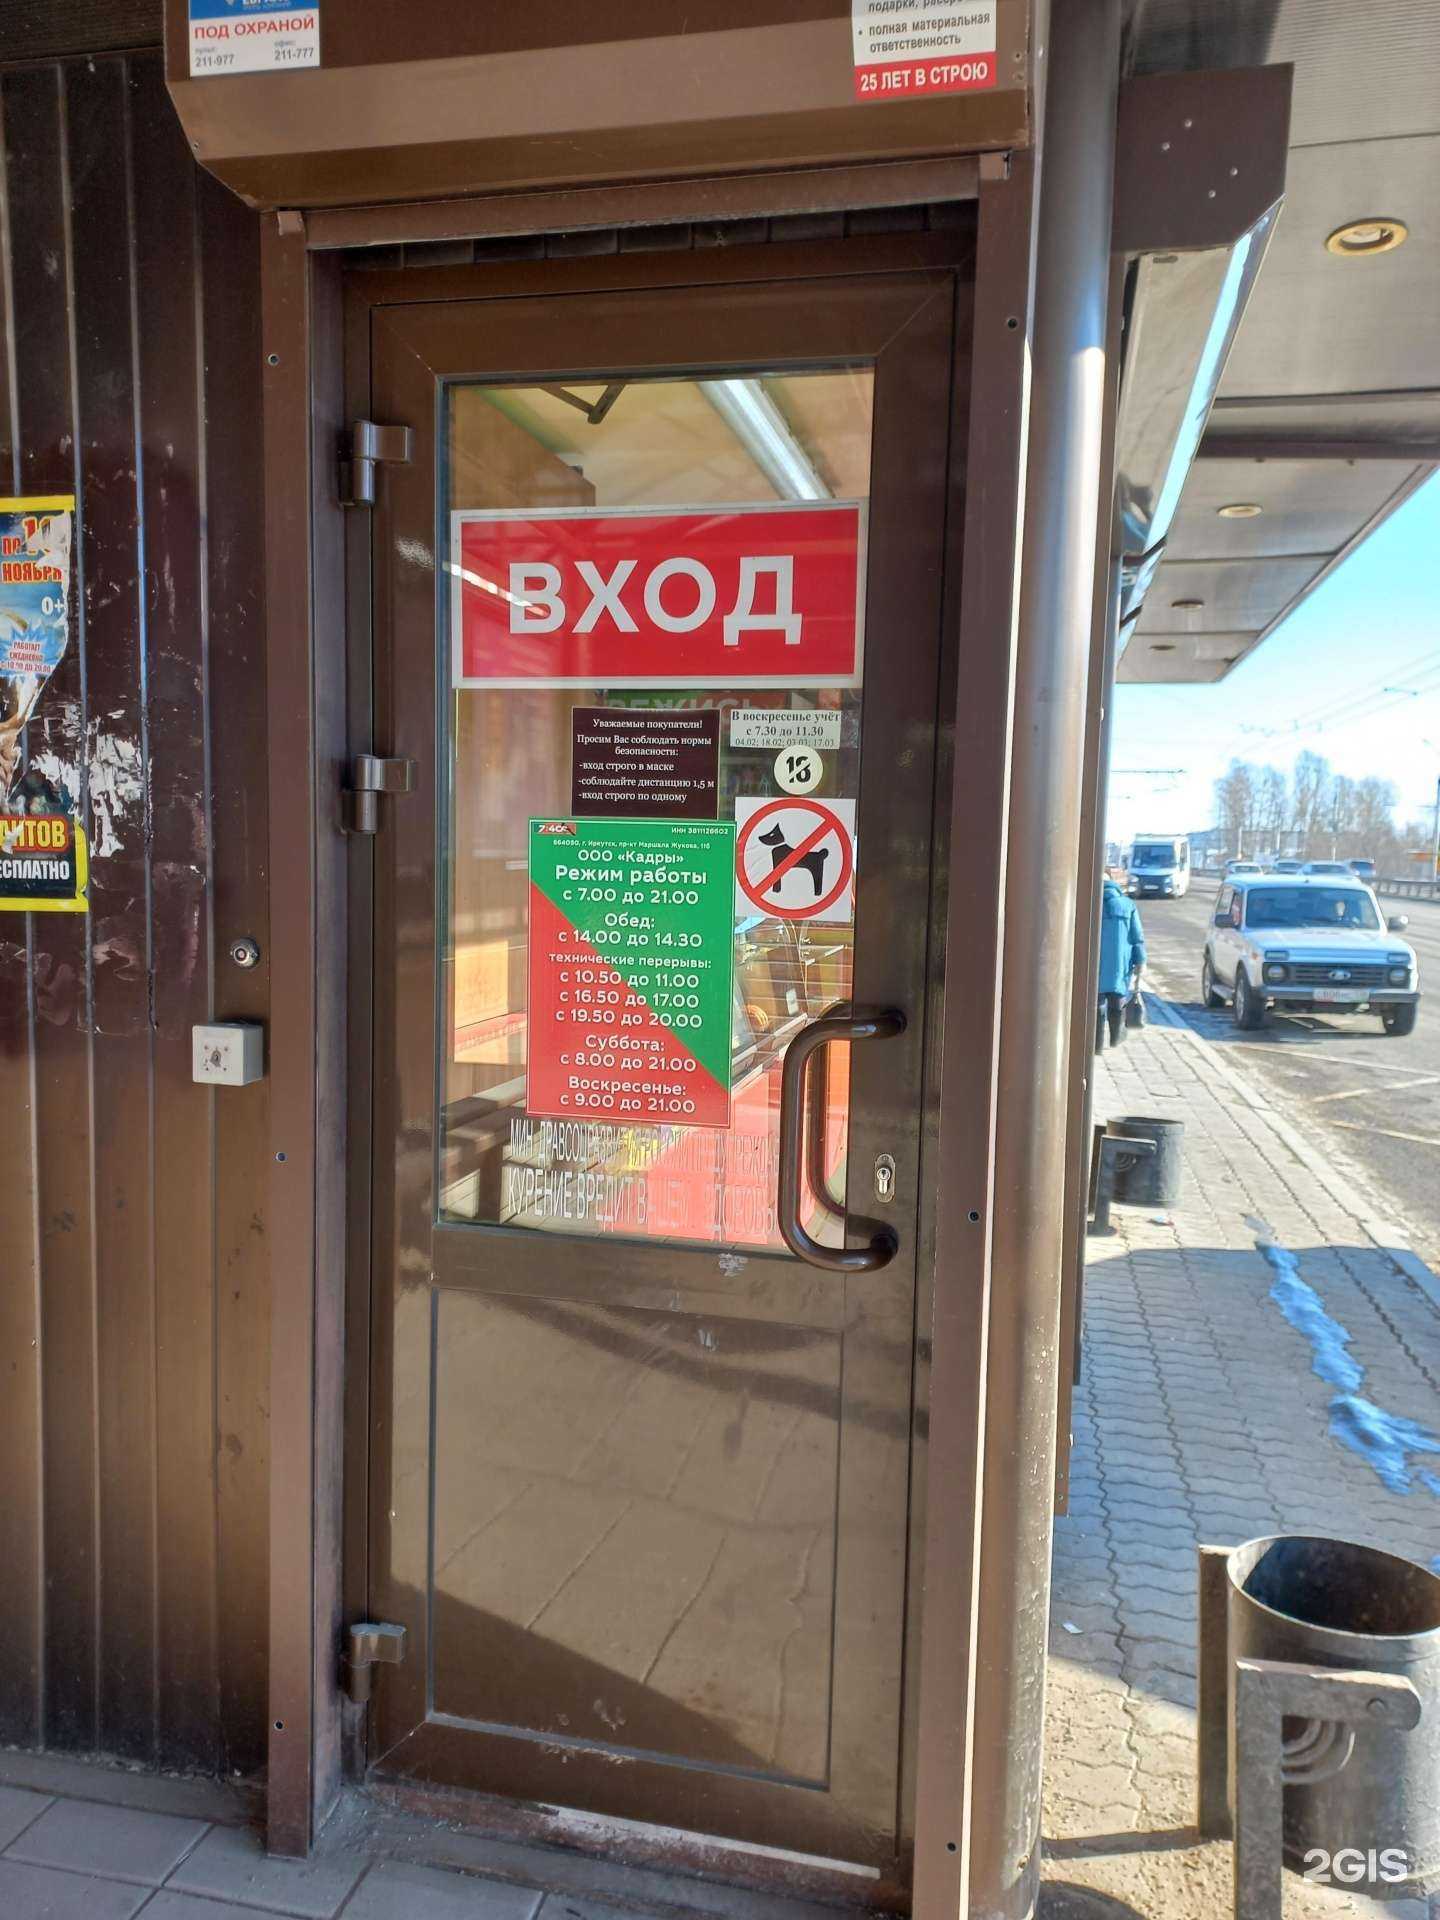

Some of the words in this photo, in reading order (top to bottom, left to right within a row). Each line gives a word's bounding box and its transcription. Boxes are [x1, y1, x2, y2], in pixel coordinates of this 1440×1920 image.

[194, 25, 230, 39] ПОД
[234, 14, 314, 36] ОХРАНОЙ
[869, 22, 907, 36] полная
[912, 13, 990, 32] материальная
[870, 34, 961, 53] ответственность
[196, 54, 235, 68] 211-977
[275, 47, 314, 61] 211-777
[860, 74, 878, 92] 25
[881, 70, 910, 90] ЛЕТ
[916, 68, 926, 86] В
[930, 62, 988, 85] СТРОЮ
[41, 596, 64, 614] 0+
[509, 555, 802, 646] ВХОД
[592, 718, 644, 728] Уважаемые
[647, 720, 703, 730] покупатели!
[732, 711, 740, 720] В
[743, 712, 811, 724] воскресенье
[814, 712, 840, 723] учёт
[577, 734, 611, 746] Просим
[614, 735, 629, 744] Вас
[630, 736, 679, 746] соблюдать
[682, 738, 712, 746] нормы
[746, 728, 752, 736] с
[755, 726, 776, 736] 7.30
[780, 728, 792, 736] до
[796, 726, 824, 736] 11.30
[614, 746, 678, 758] безопасности:
[580, 762, 604, 770] -вход
[606, 762, 636, 772] строго
[578, 776, 636, 787] -соблюдайте
[638, 779, 690, 788] дистанцию
[693, 780, 706, 790] 1,5
[578, 792, 603, 800] -вход
[604, 792, 635, 802] строго
[652, 793, 687, 802] одному
[588, 840, 618, 848] Иркутск,
[578, 850, 613, 862] ООО
[618, 851, 684, 866] «Кадры»
[556, 865, 623, 882] Режим
[630, 866, 707, 886] работы
[562, 890, 572, 900] с
[578, 888, 616, 902] 7.00
[622, 892, 644, 904] до
[651, 890, 698, 905] 21.00
[604, 912, 656, 930] Обед:
[558, 932, 568, 942] с
[573, 930, 622, 944] 14.00
[627, 934, 648, 946] до
[654, 933, 702, 948] 14.30
[549, 954, 634, 965] технические
[638, 957, 712, 969] перерывы:
[560, 972, 568, 982] с
[575, 970, 622, 984] 10.50
[628, 974, 649, 987] до
[656, 974, 699, 988] 11.00
[560, 992, 568, 1002] с
[574, 990, 620, 1004] 16.50
[624, 994, 646, 1007] до
[653, 993, 699, 1008] 17.00
[556, 1010, 565, 1021] с
[571, 1008, 615, 1023] 19.50
[620, 1014, 642, 1026] до
[649, 1013, 702, 1028] 20.00
[586, 1034, 664, 1052] Суббота:
[560, 1054, 569, 1064] с
[575, 1052, 615, 1067] 8.00
[621, 1057, 643, 1070] до
[649, 1057, 696, 1072] 21.00
[568, 1076, 686, 1095] Воскресенье:
[560, 1094, 569, 1104] с
[574, 1093, 614, 1108] 9.00
[620, 1098, 642, 1110] до
[648, 1098, 695, 1113] 21.00
[508, 1167, 572, 1218] КУРЕНИЕ
[576, 1172, 634, 1232] ВРЕДИТ
